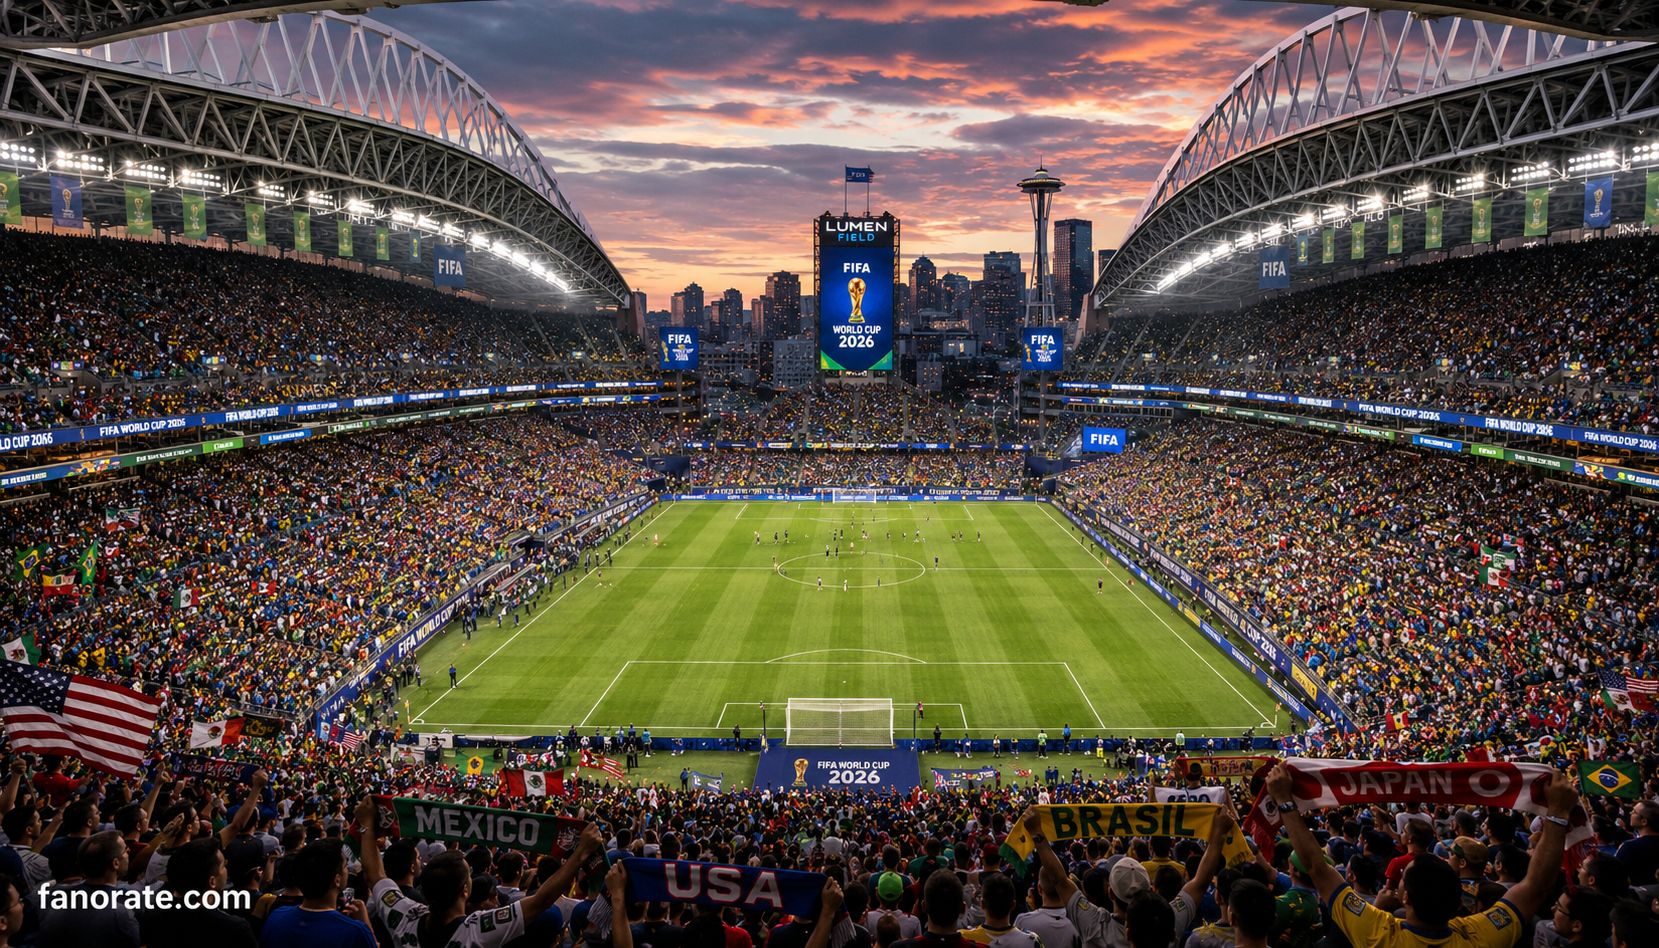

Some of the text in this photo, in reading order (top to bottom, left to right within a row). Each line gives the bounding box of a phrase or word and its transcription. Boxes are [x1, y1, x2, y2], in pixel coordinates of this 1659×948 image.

[825, 221, 888, 232] LUMEN
[838, 233, 875, 242] FIELD
[438, 258, 463, 276] FIFA
[843, 262, 871, 273] FIFA
[1262, 260, 1286, 277] FIFA
[833, 325, 882, 334] WORLD CUP
[668, 334, 692, 344] FIFA
[838, 335, 875, 348] 2026
[1031, 335, 1055, 345] FIFA
[1401, 408, 1418, 418] CUP
[99, 425, 120, 437] FIFA
[120, 422, 150, 434] WORLD
[151, 420, 167, 430] CUP
[12, 434, 30, 448] CUP
[1090, 433, 1118, 446] FIFA
[817, 761, 890, 769] FIFA WORLD CUP
[828, 770, 881, 784] 2026
[1340, 769, 1454, 796] JAPAN
[414, 804, 541, 848] MEXICO
[1049, 804, 1195, 839] BRASIL
[663, 862, 784, 910] USA
